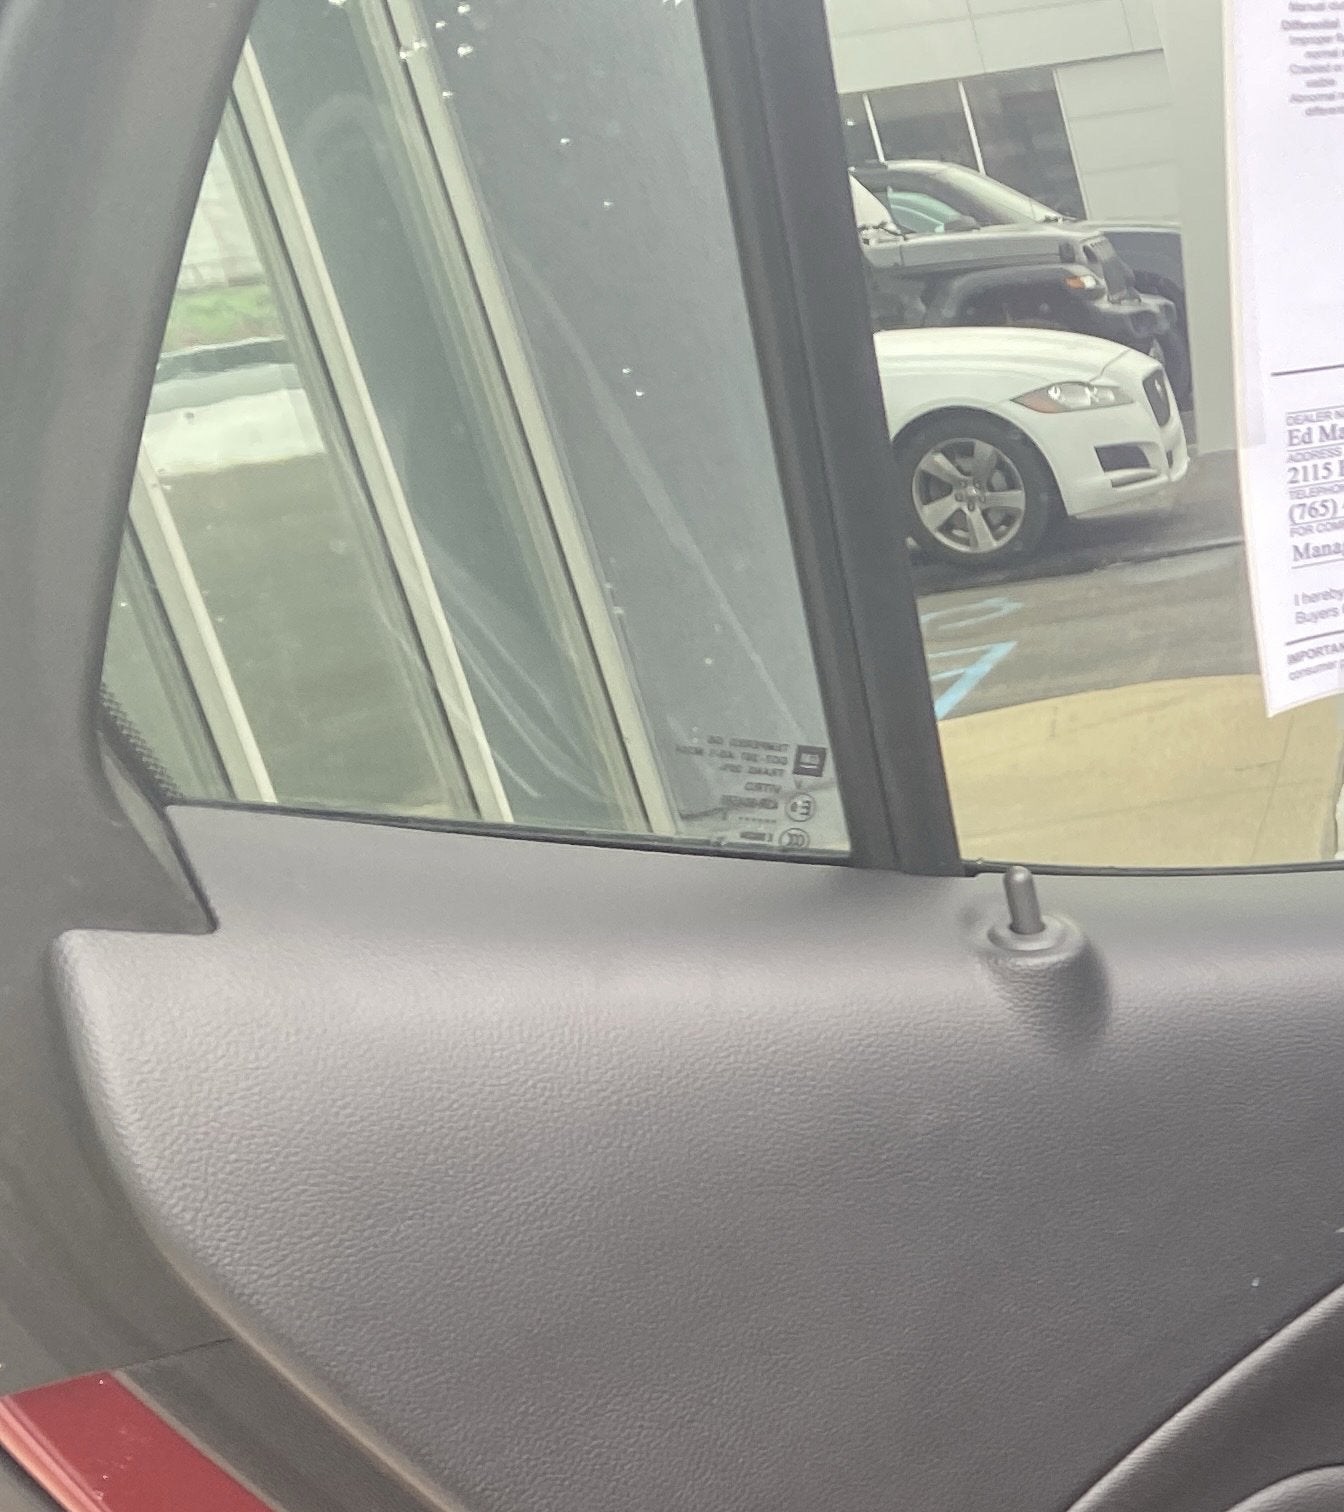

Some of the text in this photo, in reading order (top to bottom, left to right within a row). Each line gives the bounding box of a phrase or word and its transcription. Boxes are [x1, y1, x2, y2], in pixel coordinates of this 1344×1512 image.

[1287, 426, 1312, 447] Ed
[1288, 462, 1333, 484] 2115
[1289, 498, 1337, 525] (765)
